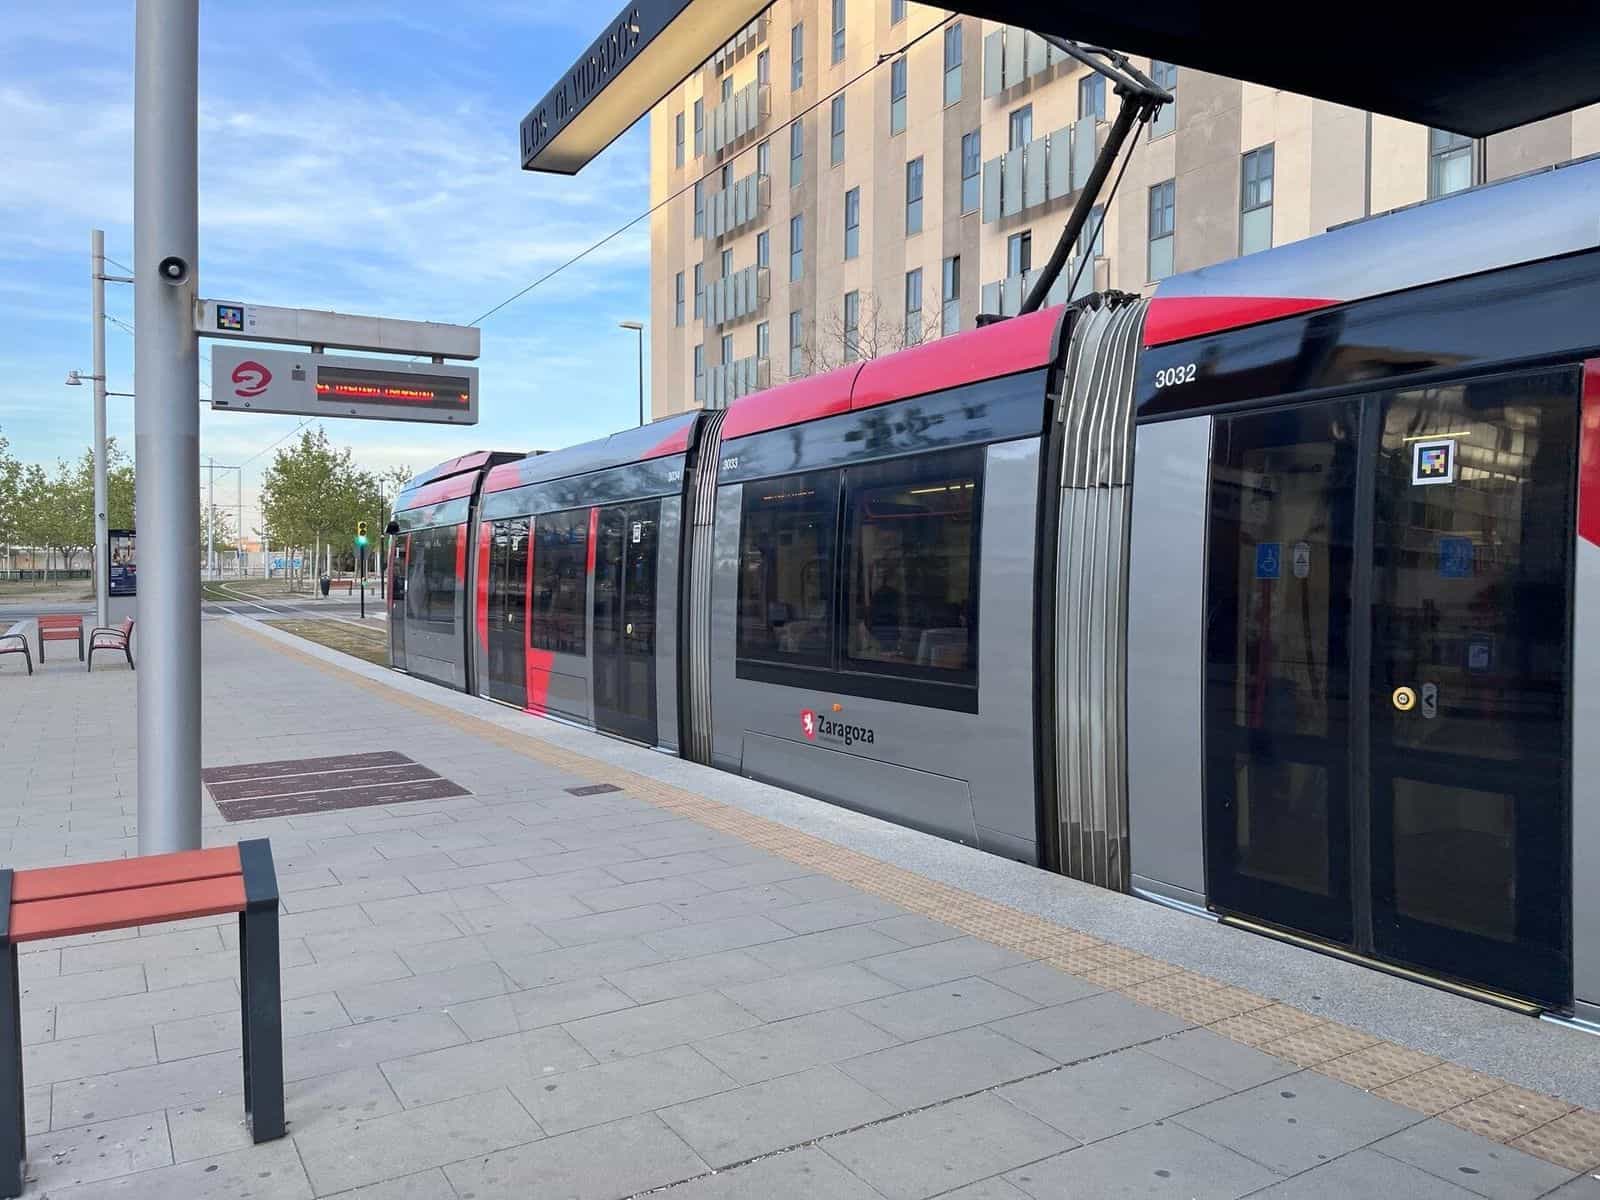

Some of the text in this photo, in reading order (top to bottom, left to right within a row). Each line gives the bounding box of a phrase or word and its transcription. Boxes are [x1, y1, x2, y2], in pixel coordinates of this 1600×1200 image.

[522, 8, 641, 158] LOS OLVIDADOS
[1155, 363, 1197, 388] 3032
[817, 714, 875, 746] Zaragoza
